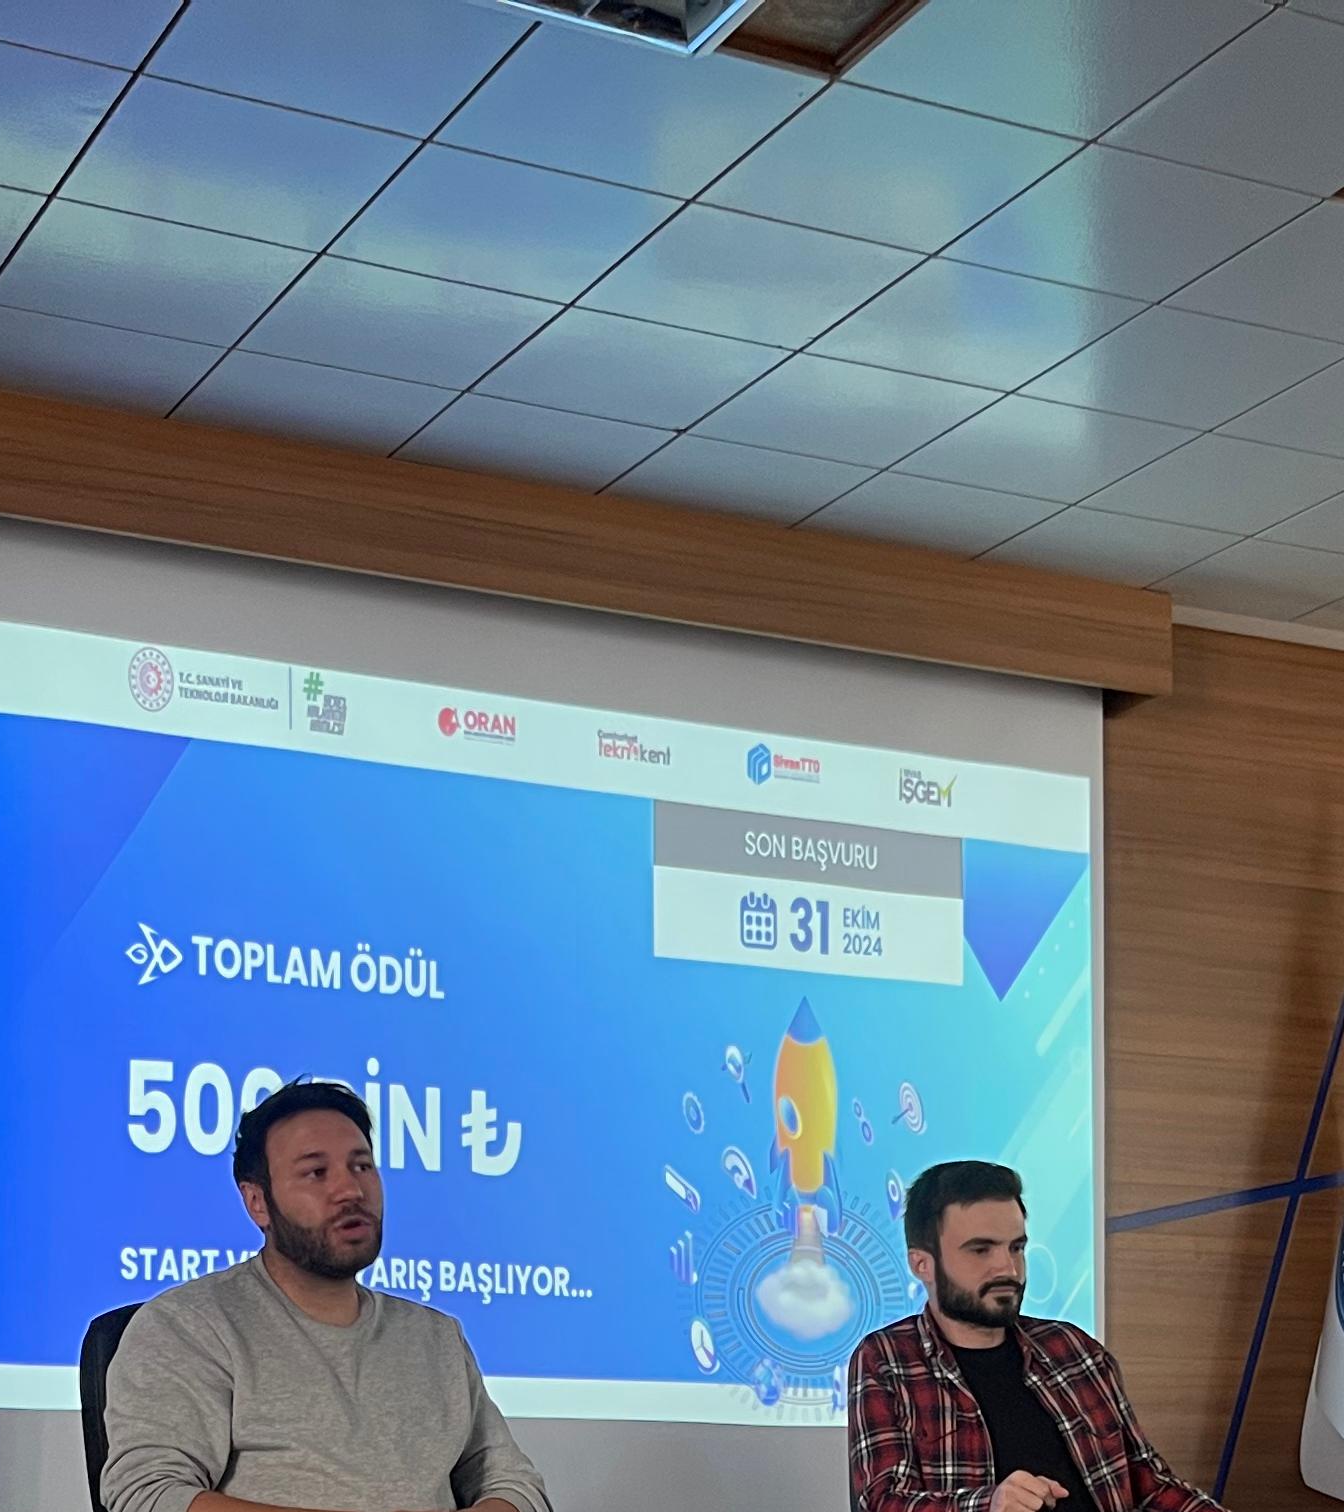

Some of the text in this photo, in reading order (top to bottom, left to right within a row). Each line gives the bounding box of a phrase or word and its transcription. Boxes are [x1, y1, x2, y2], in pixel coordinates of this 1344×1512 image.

[464, 710, 516, 736] ORAN
[744, 831, 879, 872] SON BAŞVURU
[789, 896, 830, 956] 31
[842, 904, 881, 931] EKİM
[191, 935, 445, 1000] TOPLAM ÖDÜL
[842, 933, 883, 957] 2024
[311, 1057, 441, 1172] İN
[119, 1247, 220, 1282] START
[439, 1260, 593, 1305] BAŞLIYOR...
